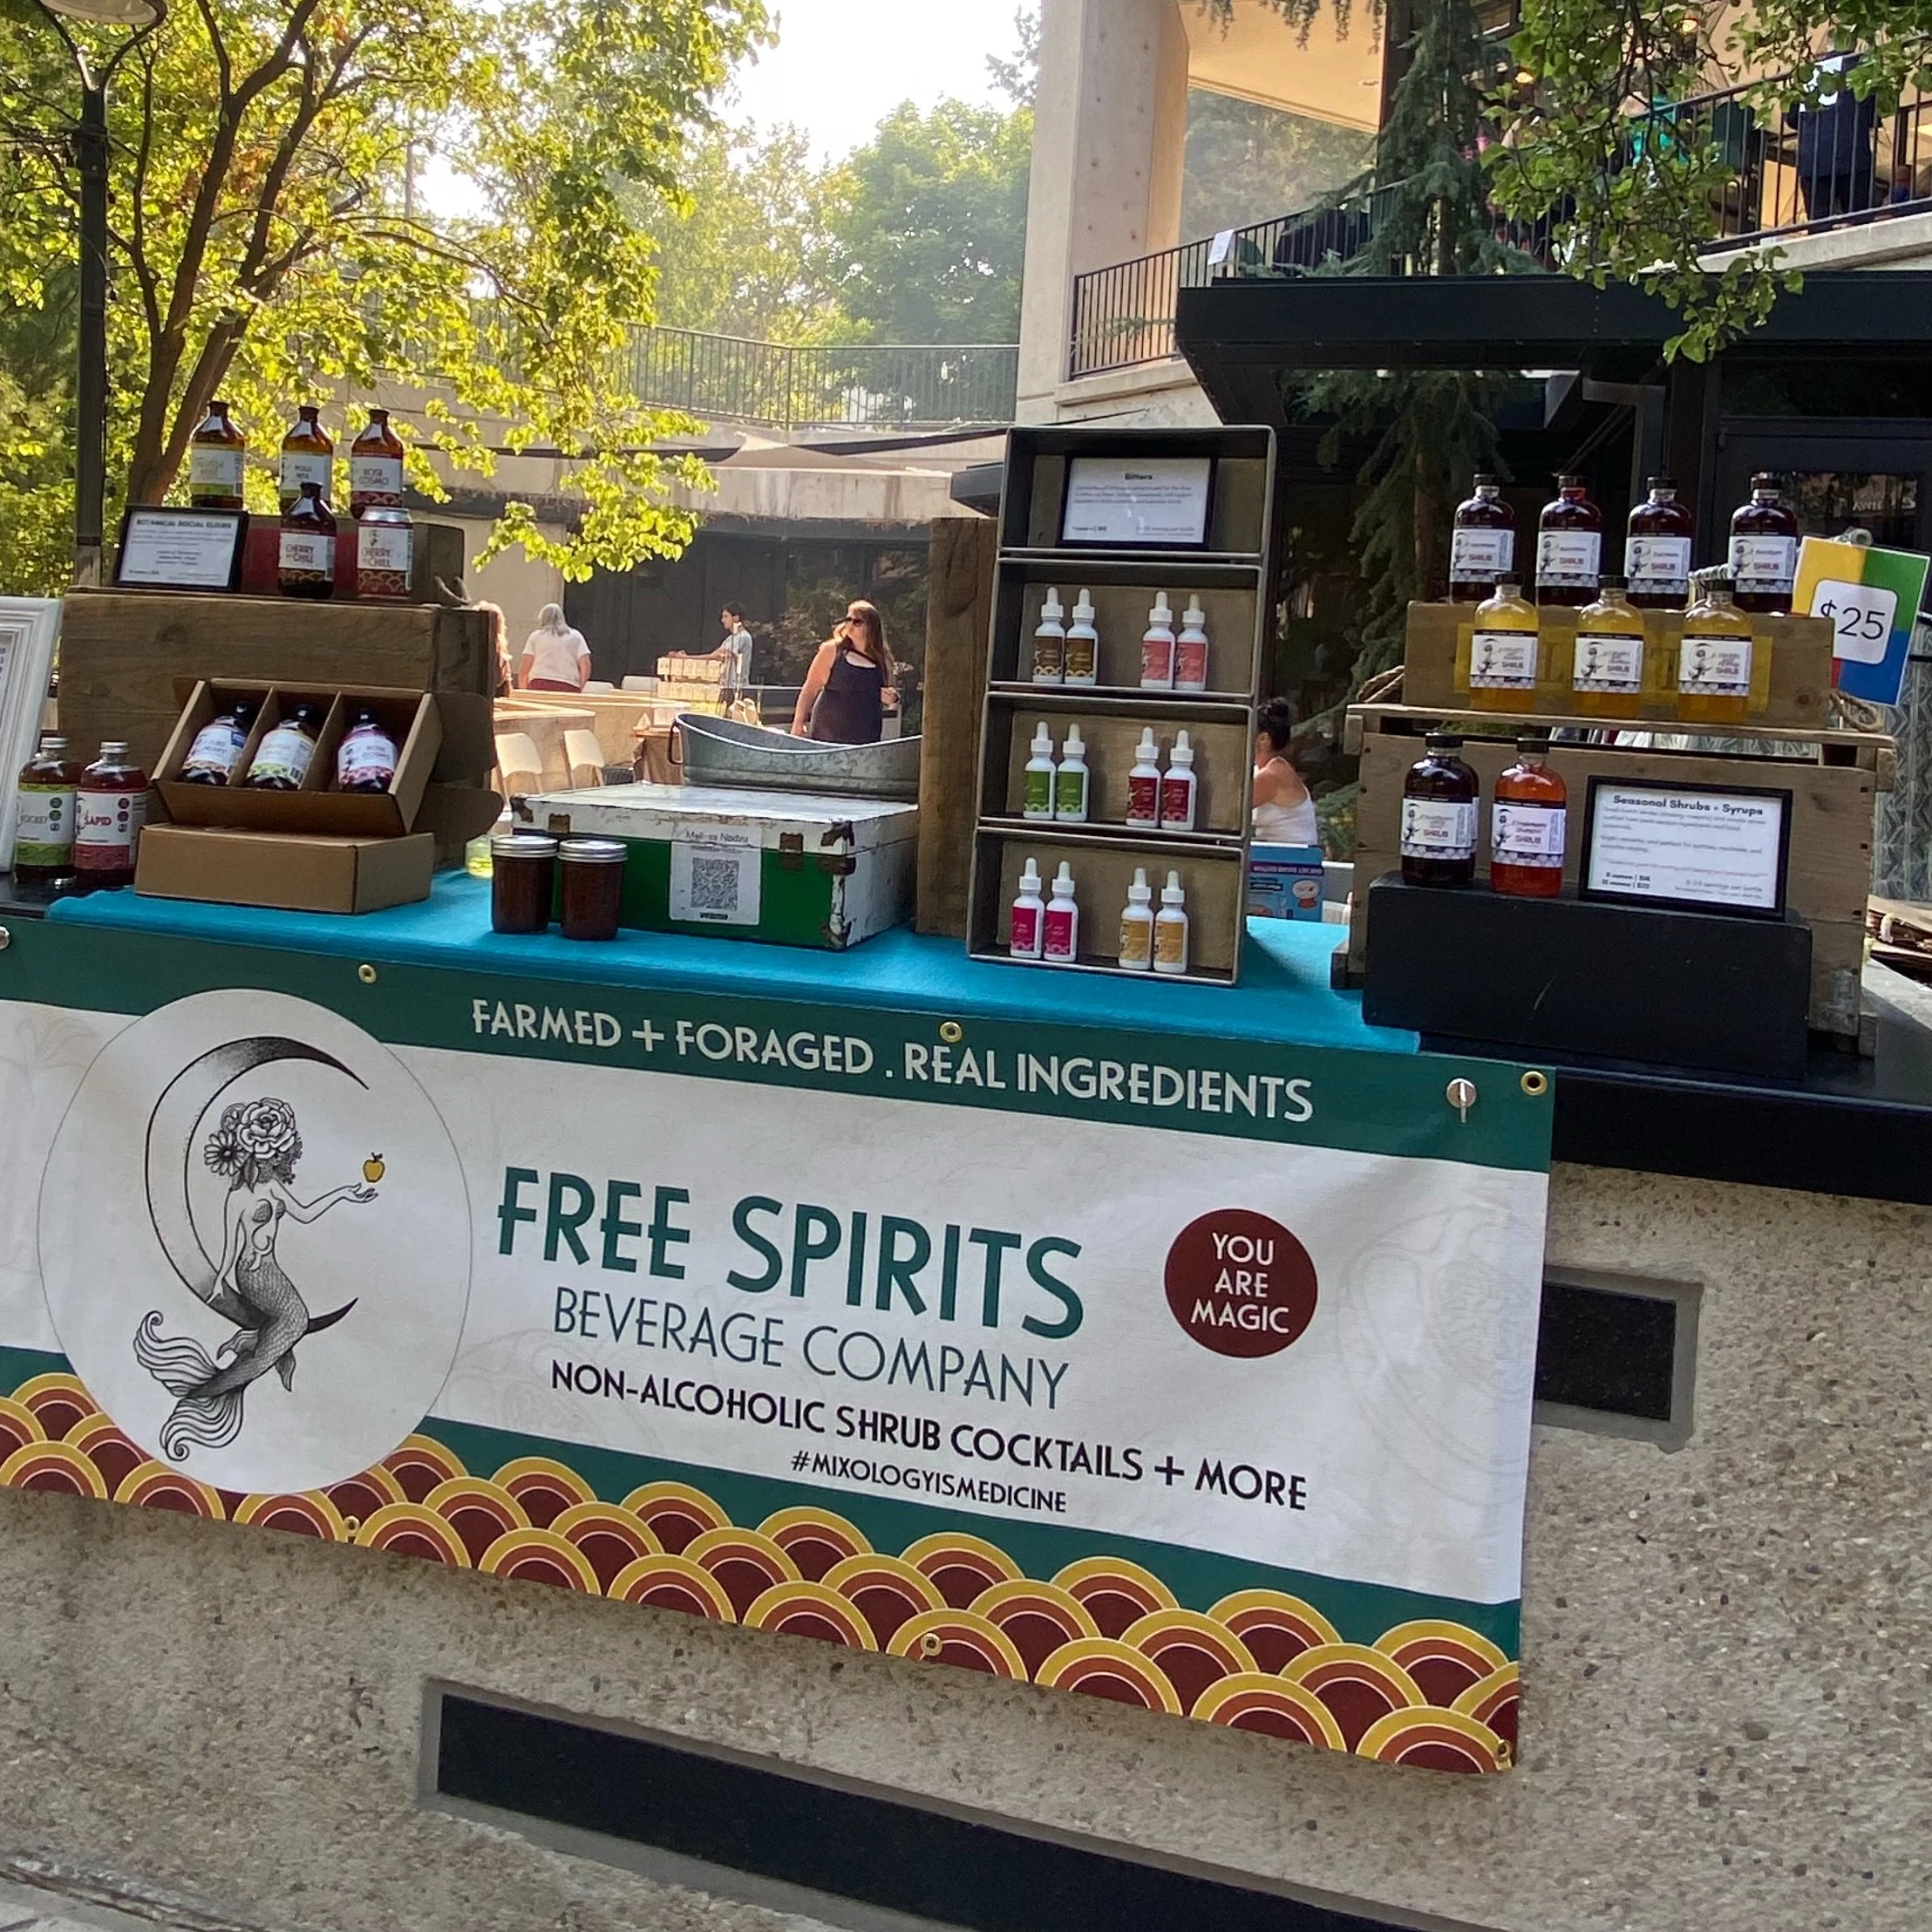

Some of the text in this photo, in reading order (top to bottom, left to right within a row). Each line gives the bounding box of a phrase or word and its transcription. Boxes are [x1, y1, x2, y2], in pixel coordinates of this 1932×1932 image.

[1820, 599, 1887, 641] $25
[1613, 794, 1667, 808] Seasonal
[1670, 799, 1711, 812] Shrubs
[1722, 803, 1764, 818] Syrups
[473, 998, 622, 1047] FARMED
[675, 1019, 874, 1075] FORAGED
[904, 1043, 1006, 1089] REAL
[1017, 1052, 1314, 1123] INGREDIENTS
[497, 1166, 1085, 1340] FREE SPIRITS
[1212, 1232, 1275, 1266] YOU
[1214, 1268, 1269, 1298] ARE
[1190, 1297, 1290, 1334] MAGIC
[553, 1286, 1071, 1410] BEVERAGE COMPANY
[551, 1358, 826, 1433] NON-ALCOHOLIC
[835, 1405, 942, 1452] SHRUB
[950, 1424, 1144, 1481] COCKTAILS
[1194, 1457, 1307, 1512] MORE
[791, 1449, 1067, 1514] #MIXOLOGYISMEDICINE
